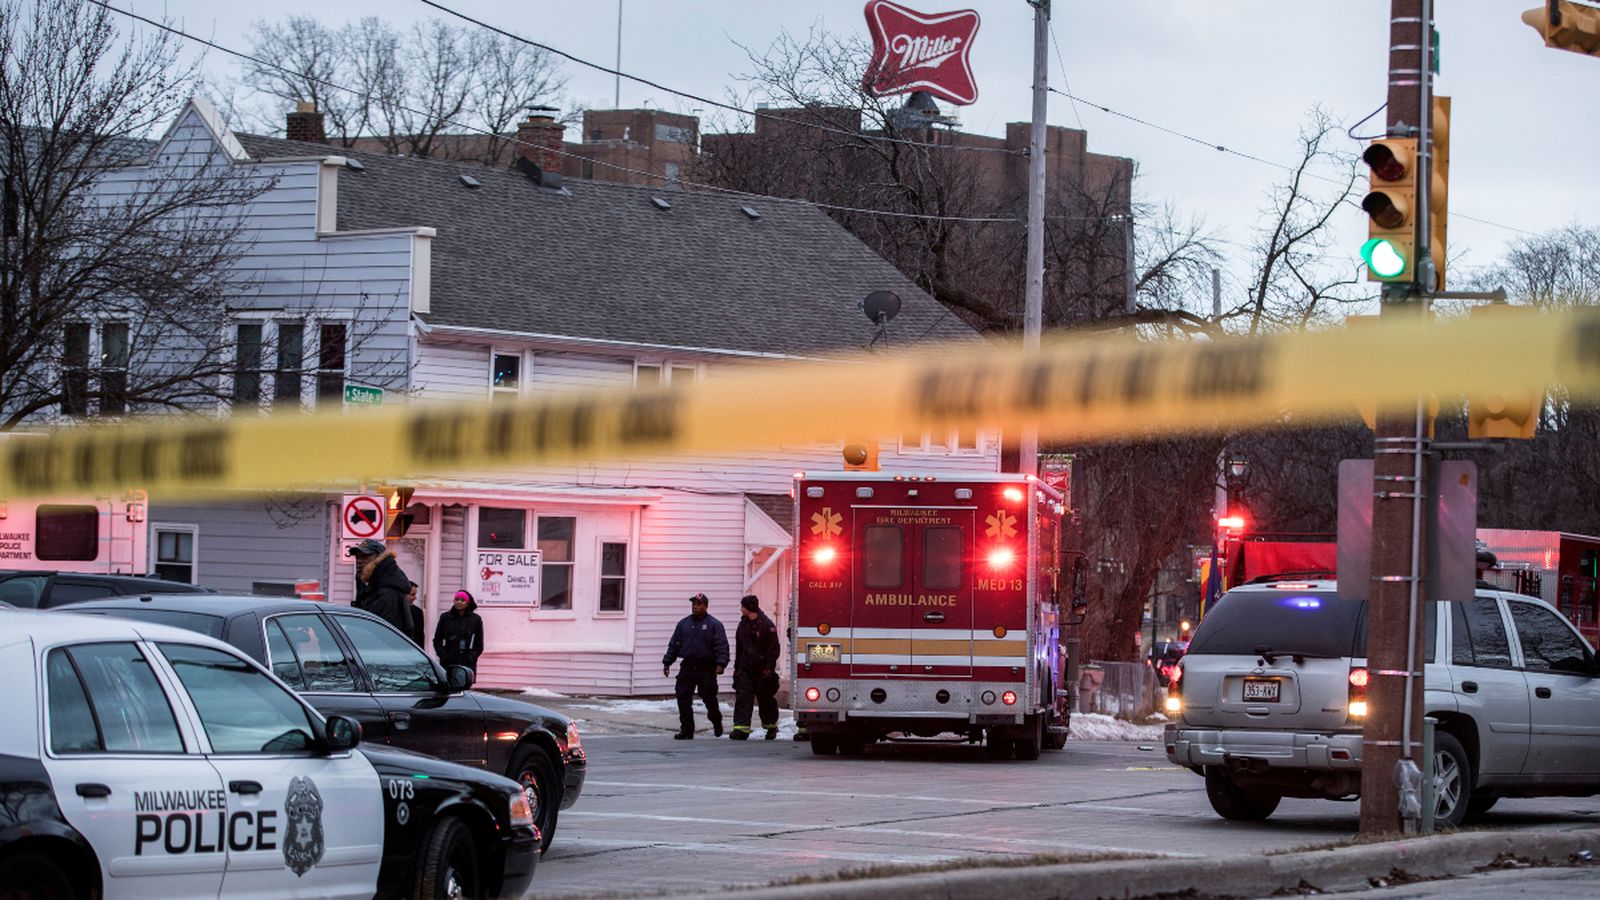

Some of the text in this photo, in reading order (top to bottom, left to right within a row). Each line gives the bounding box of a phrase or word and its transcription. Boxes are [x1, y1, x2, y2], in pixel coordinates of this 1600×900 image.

[891, 33, 962, 69] Miller
[351, 388, 374, 403] State
[889, 509, 938, 517] MILWAUKEE
[898, 517, 952, 525] DEPARTMENT
[478, 553, 538, 567] FOR SALE
[808, 581, 828, 589] CALL
[978, 579, 1023, 591] MED 13
[865, 593, 957, 607] AMBULANCE
[388, 779, 415, 800] 073
[134, 789, 226, 812] MILWAUKEE
[134, 810, 277, 856] POLICE
